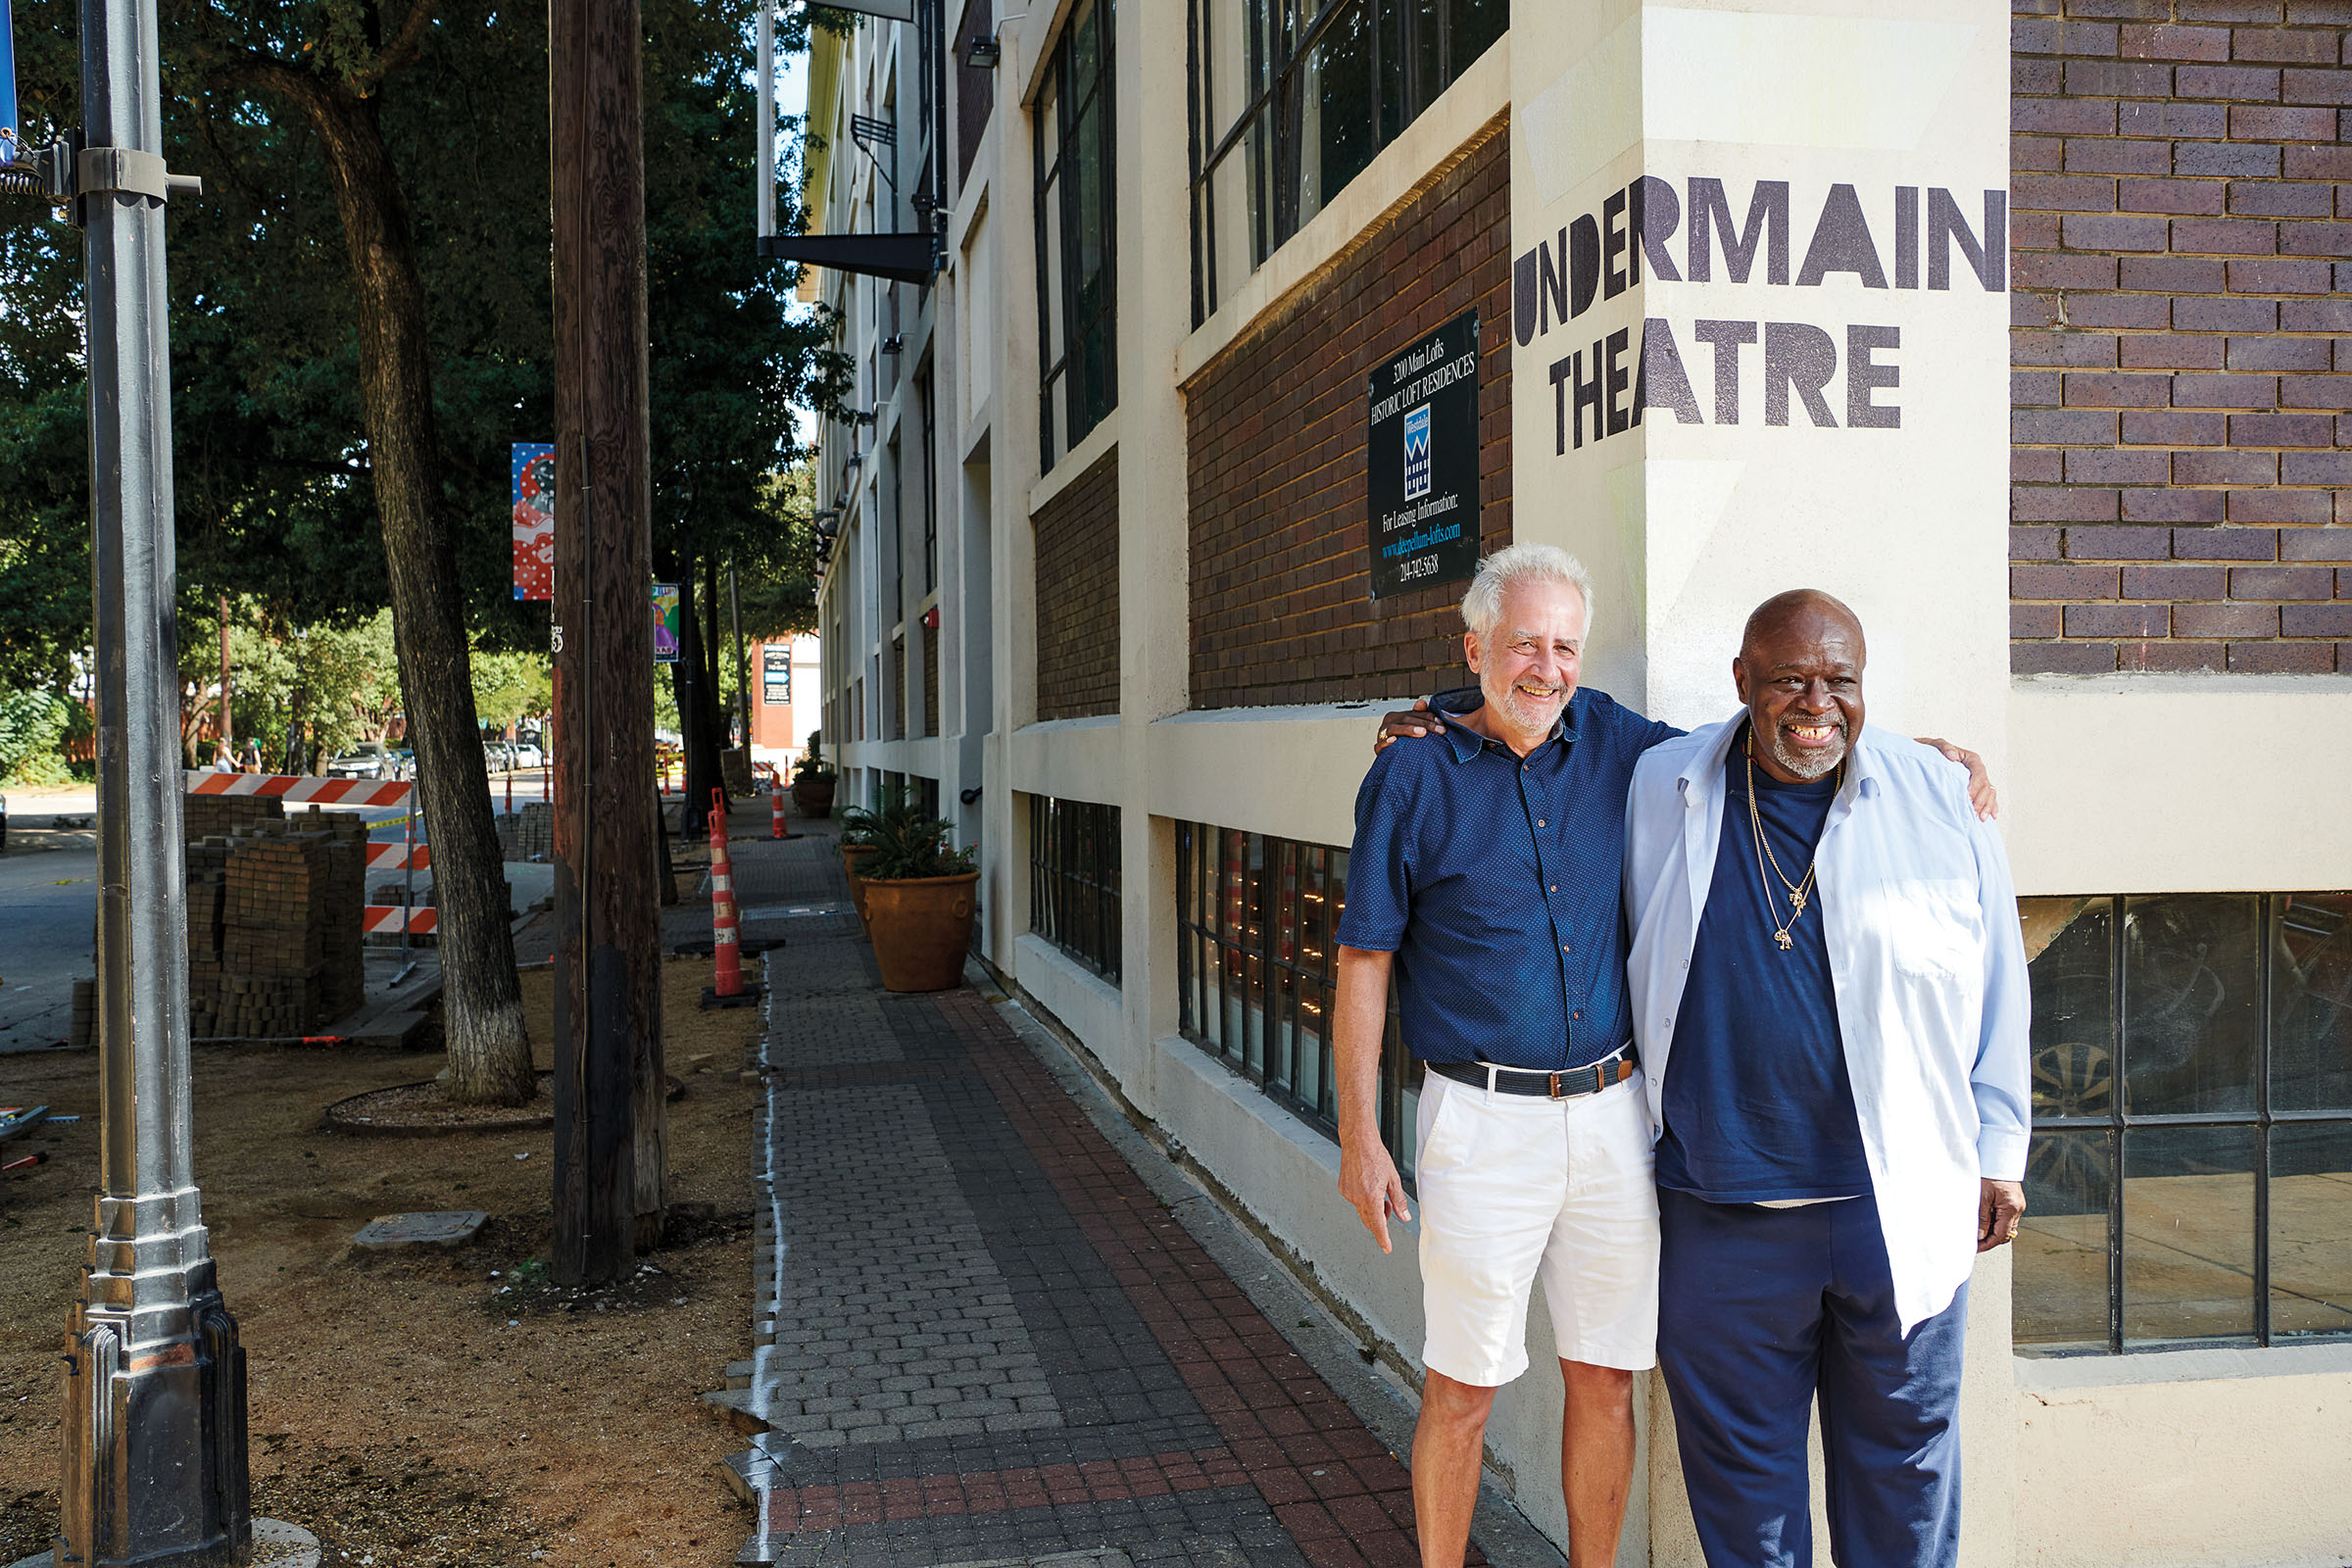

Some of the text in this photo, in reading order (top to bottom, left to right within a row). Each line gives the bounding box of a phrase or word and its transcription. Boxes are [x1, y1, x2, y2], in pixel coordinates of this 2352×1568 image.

[1513, 174, 2007, 348] UNDERMAIN
[1393, 337, 1445, 385] 3200 Main Lofts
[1371, 351, 1475, 426] HISTORIC LOFT RESIDENCES
[1549, 317, 1902, 458] THEATRE
[1405, 414, 1429, 435] Westdale
[1383, 491, 1458, 533] For Leasing Information:
[1382, 522, 1461, 560] www.deepellum-lofts.com
[1399, 553, 1439, 583] 214-742-5638
